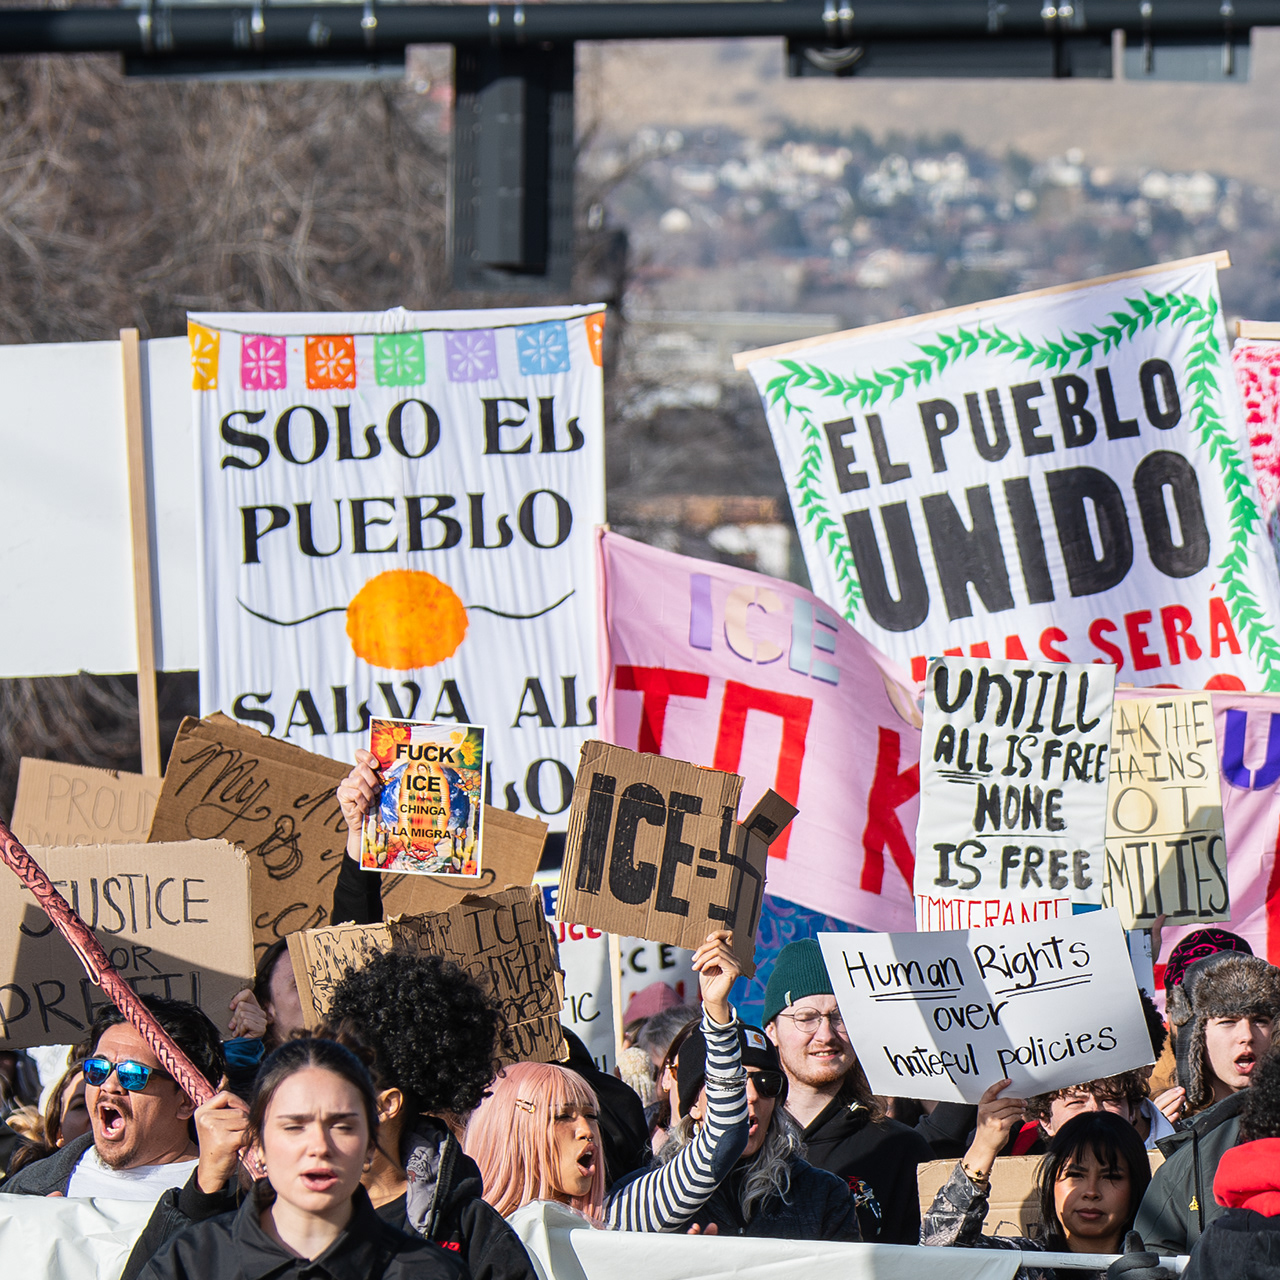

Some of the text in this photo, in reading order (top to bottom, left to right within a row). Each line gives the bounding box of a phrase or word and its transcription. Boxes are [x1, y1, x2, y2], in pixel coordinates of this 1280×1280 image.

[220, 396, 586, 471] SOLO EL
[822, 358, 1183, 495] EL PUEBLO
[240, 488, 574, 564] PUEBLO
[842, 450, 1211, 634] UNIDO
[689, 573, 840, 686] ICE
[231, 675, 598, 740] SALVA AL
[1156, 700, 1213, 749] THE
[396, 743, 455, 763] FUCK
[933, 723, 1107, 785] ALL IS FREE
[175, 742, 270, 839] My
[400, 804, 446, 815] CHINGA
[406, 775, 441, 792] ICE
[973, 783, 1068, 834] NONE
[1112, 786, 1207, 834] OT
[393, 827, 452, 839] LA MIGRA
[932, 839, 1094, 892] IS FREE
[19, 873, 209, 937] JUSTICE
[107, 945, 161, 973] OR
[842, 935, 1091, 991] Human Rights
[933, 1000, 1009, 1032] over
[883, 1026, 1118, 1086] hateful policies
